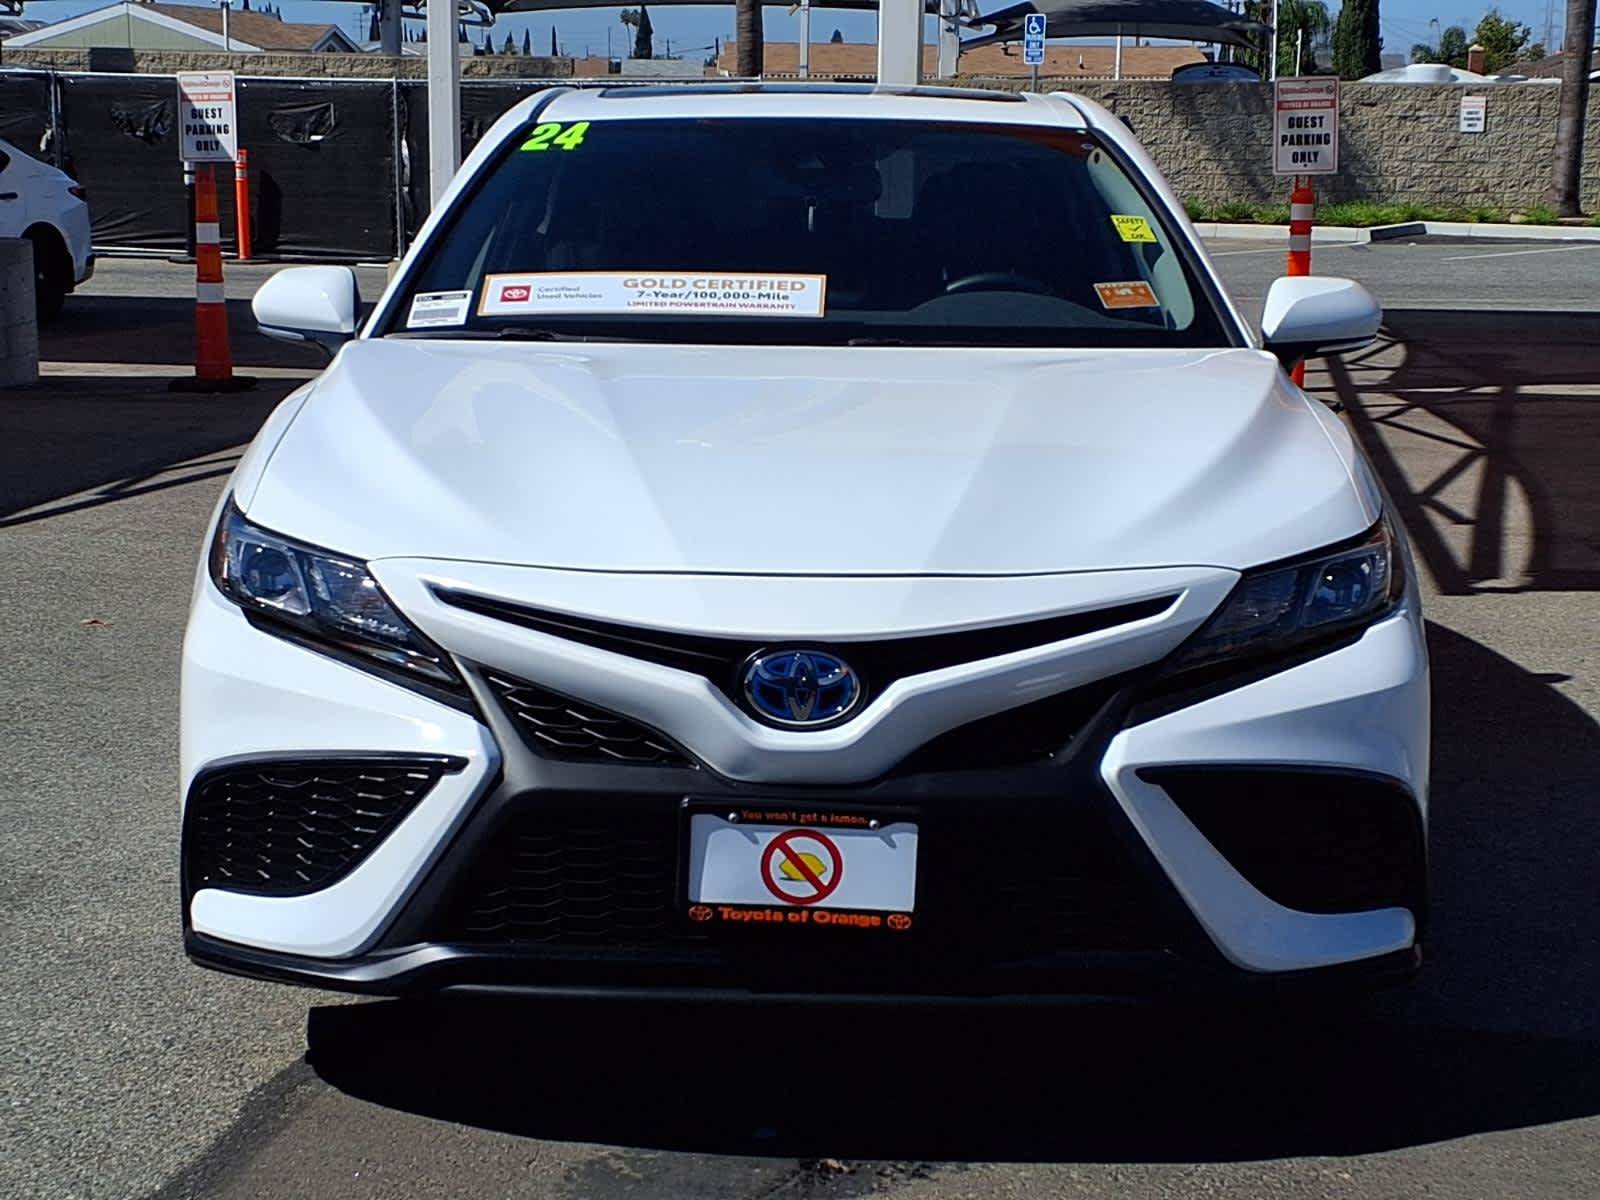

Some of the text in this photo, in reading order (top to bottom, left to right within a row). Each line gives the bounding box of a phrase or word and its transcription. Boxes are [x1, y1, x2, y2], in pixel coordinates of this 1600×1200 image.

[190, 107, 223, 119] GUEST
[1287, 116, 1325, 129] GUEST
[185, 124, 230, 136] PARKING
[520, 121, 591, 151] 24
[195, 140, 221, 152] ONLY
[1281, 133, 1331, 147] PARKING
[1292, 151, 1320, 164] ONLY
[623, 278, 807, 291] GOLD CERTIFIED
[636, 290, 791, 301] 7-Year/100,000-Mile
[626, 300, 798, 310] LIMITED POWERTRAIN WARRANTY
[742, 809, 762, 820] You
[765, 811, 797, 821] won't
[800, 812, 820, 824] get
[718, 905, 882, 928] Toyota of Orange
